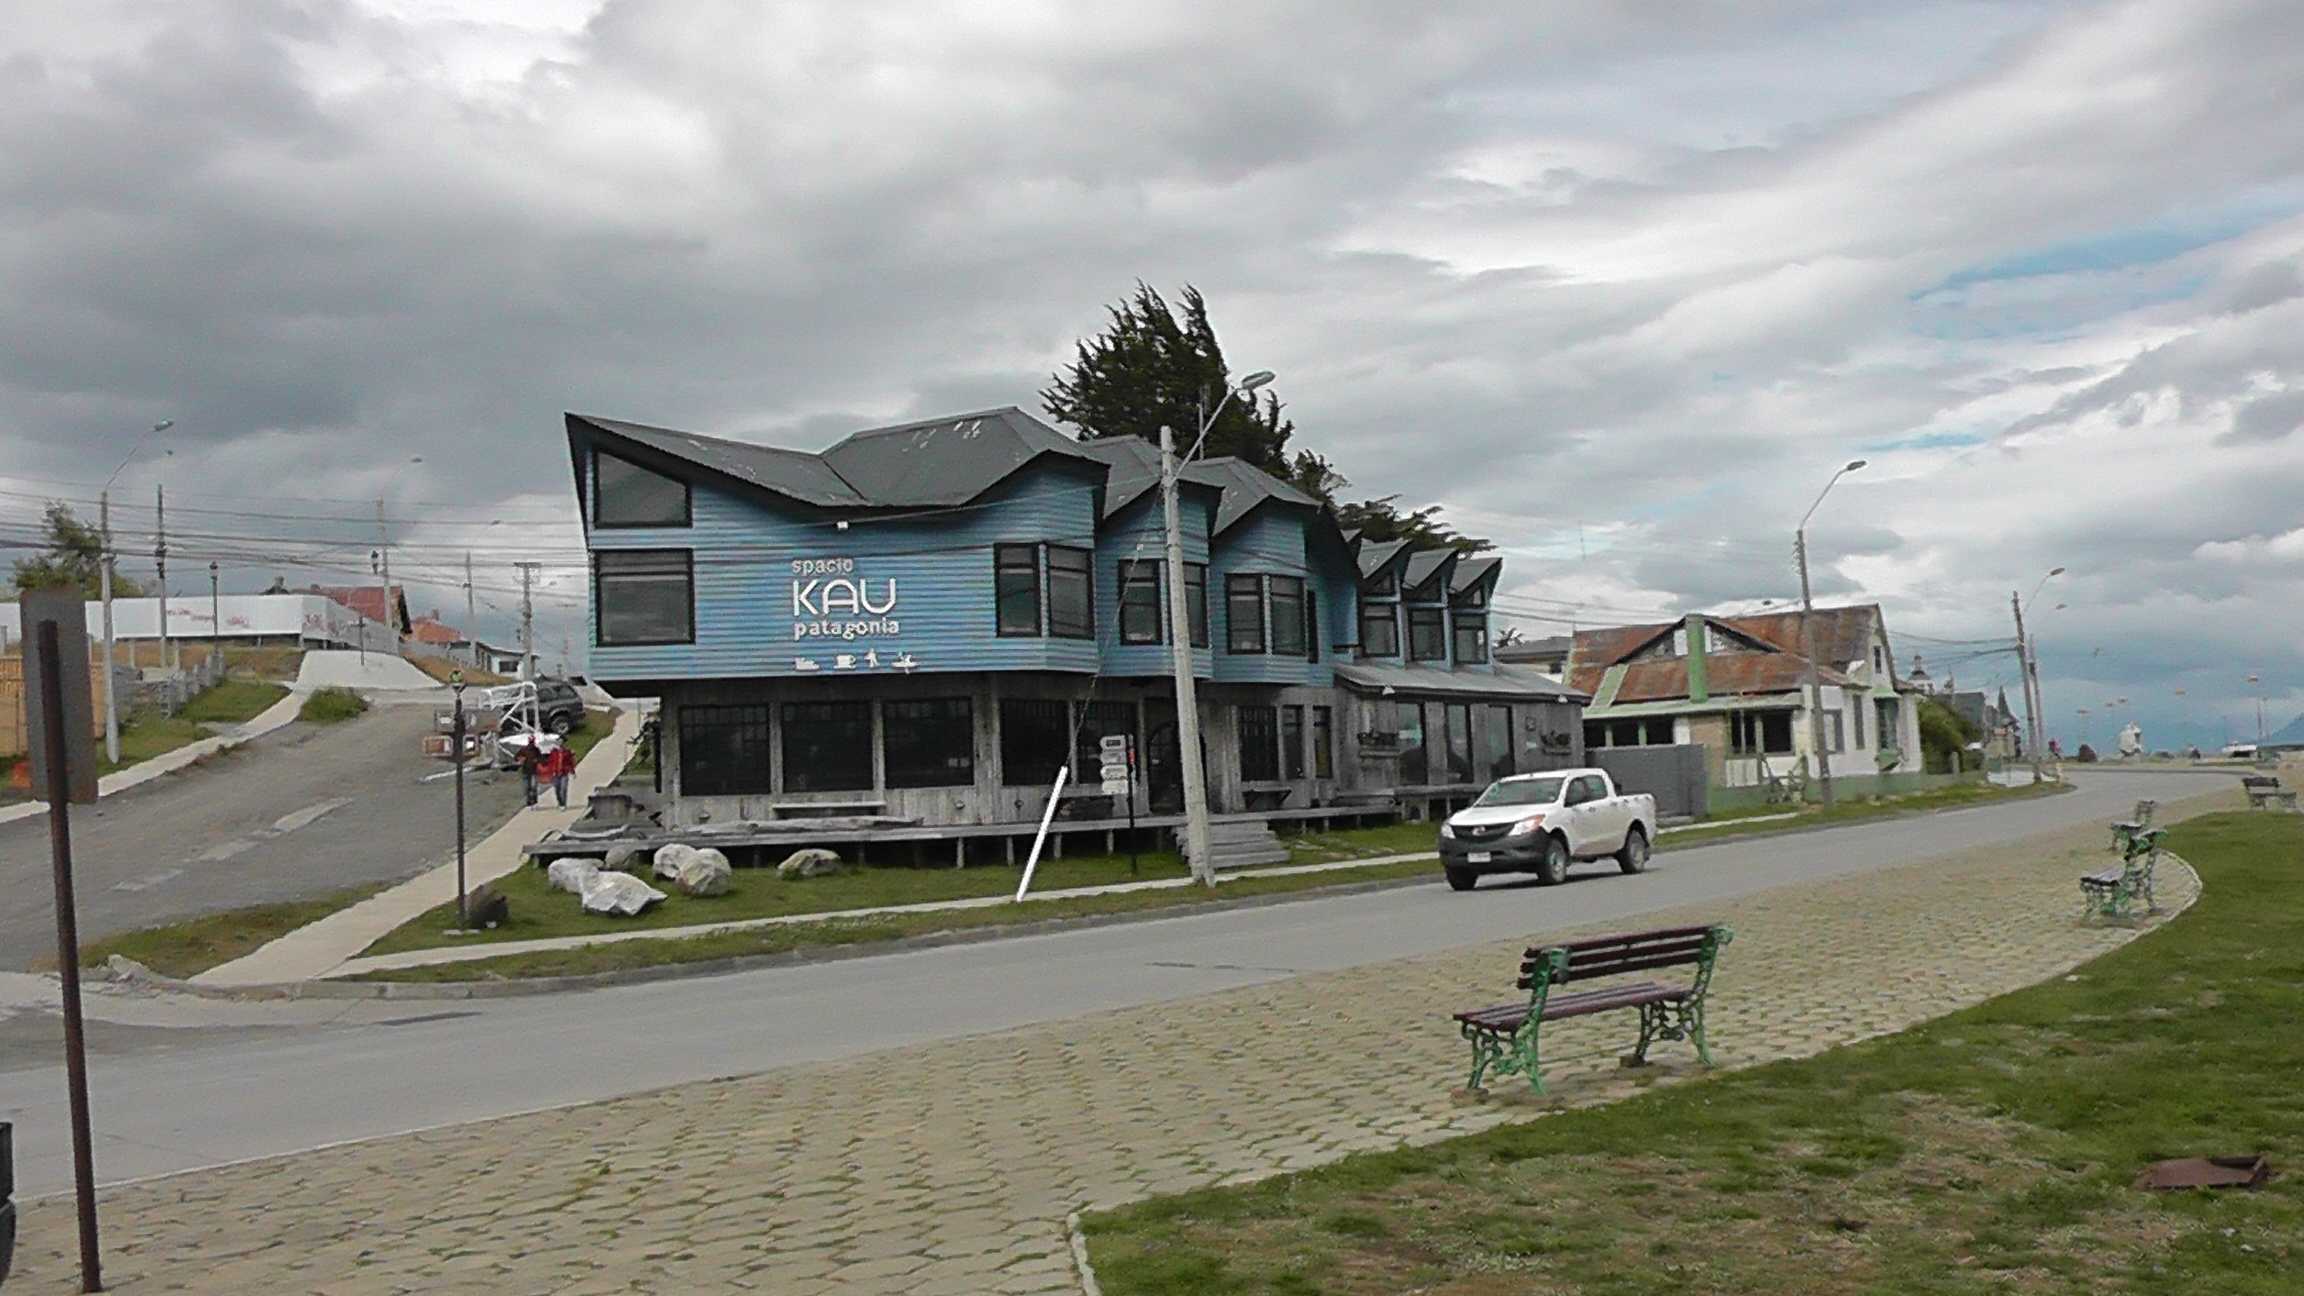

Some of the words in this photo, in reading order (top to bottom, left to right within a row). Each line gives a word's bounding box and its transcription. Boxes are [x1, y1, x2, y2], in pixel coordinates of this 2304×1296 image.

[791, 559, 854, 576] spacio
[793, 578, 896, 616] KAU
[794, 617, 900, 641] patagonia
